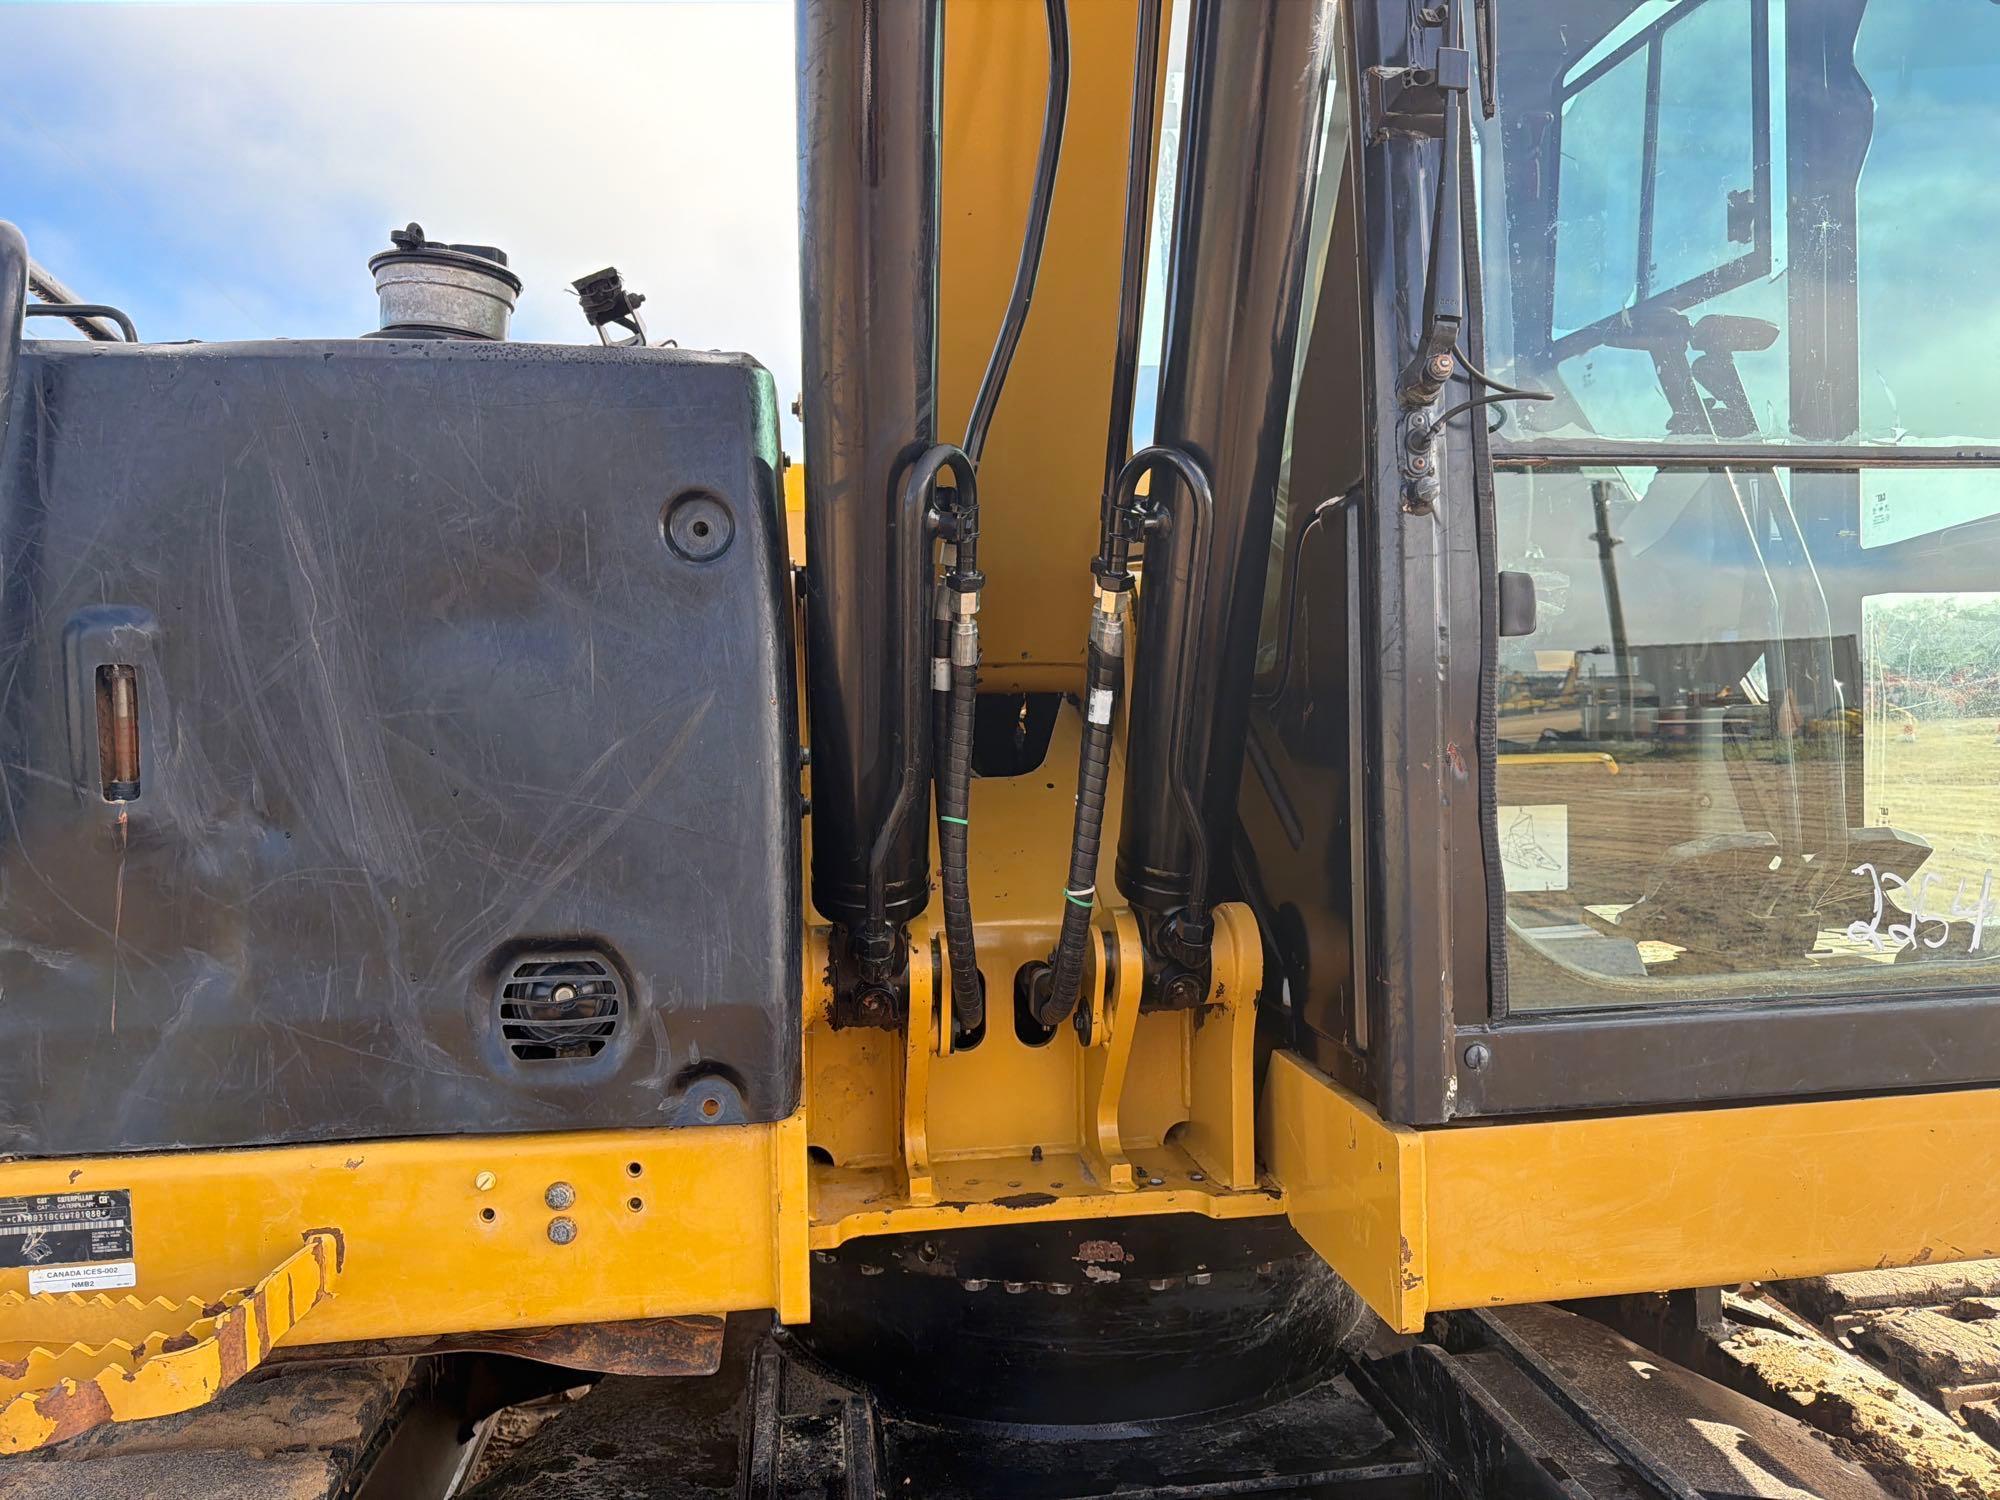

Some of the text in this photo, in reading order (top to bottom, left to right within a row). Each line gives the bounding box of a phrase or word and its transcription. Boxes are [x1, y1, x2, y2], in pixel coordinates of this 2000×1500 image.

[1847, 863, 1996, 953] 2254
[57, 1194, 95, 1203] CATERPILLAR
[46, 1267, 119, 1279] CANADA ICES-002
